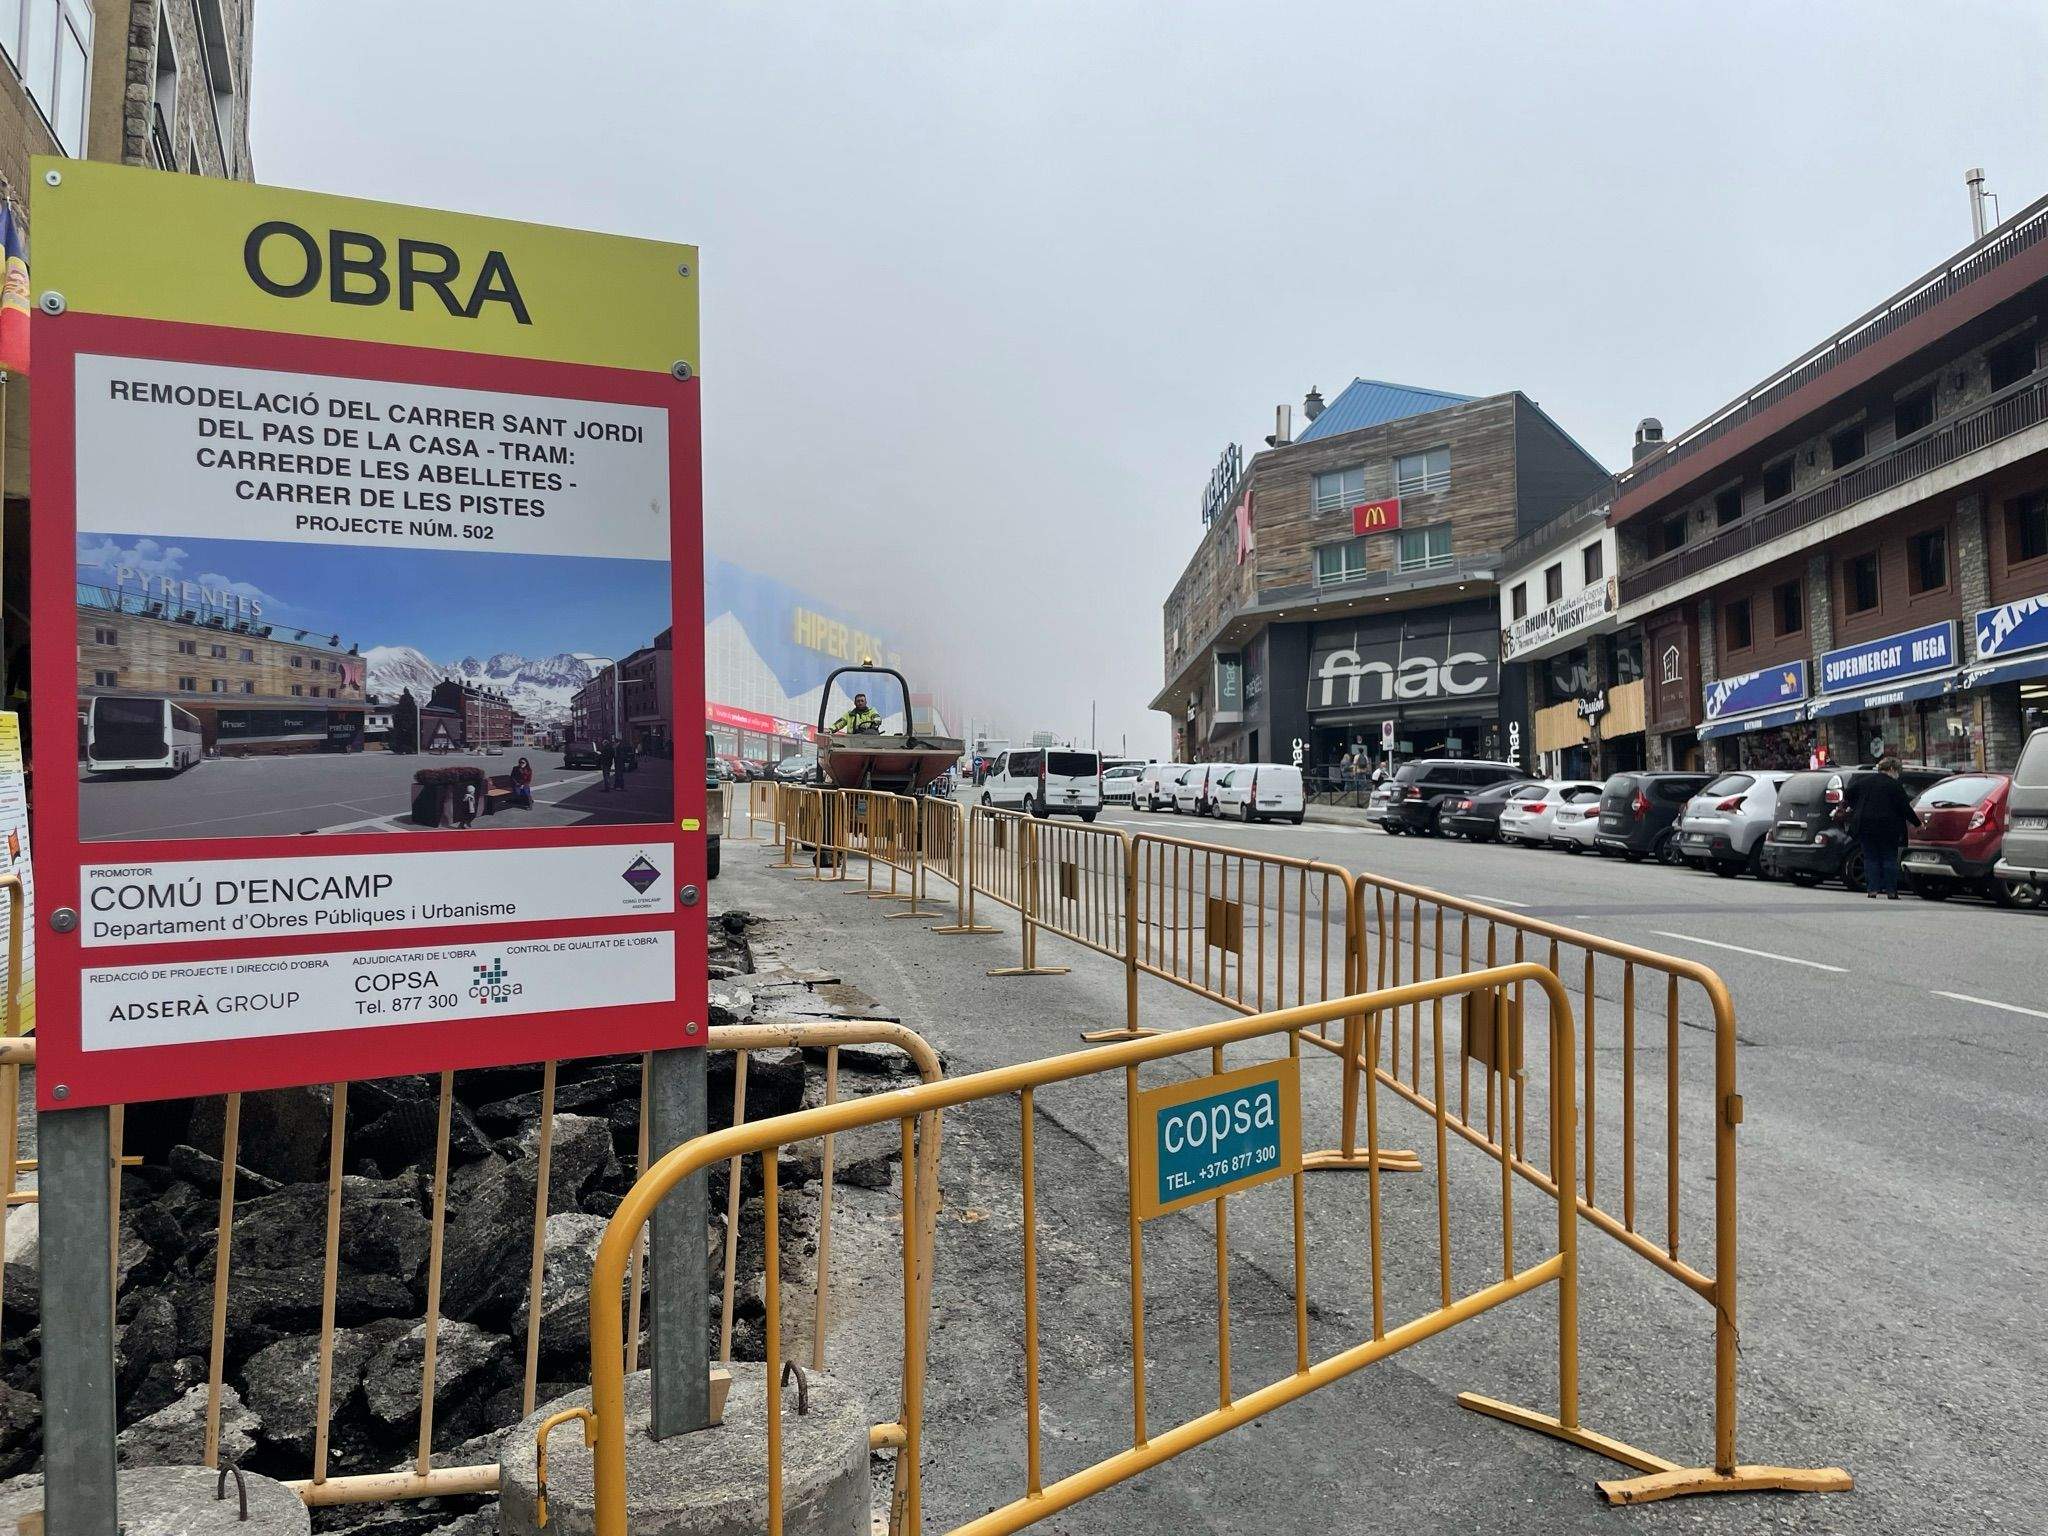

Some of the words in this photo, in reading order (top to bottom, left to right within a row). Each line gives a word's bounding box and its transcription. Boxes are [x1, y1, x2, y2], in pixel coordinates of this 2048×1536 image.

[244, 221, 533, 325] OBRA
[110, 380, 320, 416] REMODELACIÓ
[329, 399, 380, 422] DEL
[388, 404, 495, 431] CARRER
[502, 414, 568, 437] SANT
[574, 422, 643, 443] JORDI
[199, 418, 253, 441] DEL
[263, 422, 315, 445] PAS
[324, 427, 359, 449] DE
[368, 431, 401, 452] LA
[409, 434, 480, 458] CASA
[499, 442, 576, 465] TRAM:
[196, 448, 351, 477] CARRERDE
[361, 459, 410, 481] LES
[418, 464, 563, 491] ABELLETES
[235, 480, 351, 506] CARRER
[360, 488, 395, 509] DE
[403, 491, 452, 513] LES
[460, 495, 545, 518] PISTES
[296, 515, 403, 535] PROJECTE
[410, 519, 457, 538] NÚM.
[463, 525, 494, 539] 502
[794, 607, 848, 660] HIPER
[854, 630, 883, 668] PAS
[1525, 611, 1548, 634] RHUM
[1556, 605, 1585, 634] WHISKY
[1826, 646, 1902, 683] SUPERMERCAT
[1912, 635, 1946, 663] MEGA
[1223, 660, 1236, 697] fnac
[1318, 650, 1489, 706] fnac
[1865, 691, 1904, 708] SUPERMERCAT
[1292, 737, 1303, 772] nac
[1507, 721, 1520, 767] fnac
[90, 868, 153, 878] PROMOTOR
[91, 877, 201, 911] COMÚ
[216, 874, 393, 905] D'ENCAMP
[94, 915, 226, 939] Departament
[315, 908, 406, 926] Públiques
[411, 905, 416, 919] i
[422, 902, 516, 919] Urbanisme
[352, 953, 425, 965] ADJUDICATARI
[427, 952, 440, 961] DE
[442, 950, 477, 959] L'OBRA
[506, 945, 551, 955] CONTROL
[553, 943, 566, 951] DE
[568, 940, 611, 950] QUALITAT
[613, 939, 625, 947] DE
[627, 937, 659, 946] L'OBRA
[90, 971, 149, 984] REDACCIÓ
[152, 970, 167, 980] DE
[170, 967, 227, 978] PROJECTE
[237, 962, 288, 974] DIRECCIÓ
[290, 960, 330, 969] D'OBRA
[355, 971, 439, 993] COPSA
[109, 994, 210, 1022] ADSERÀ
[216, 991, 300, 1014] GROUP
[355, 1000, 386, 1015] Tel.
[392, 996, 422, 1012] 877
[428, 994, 458, 1009] 300
[468, 983, 523, 1000] copsa
[1165, 1093, 1274, 1153] copsa
[1167, 1170, 1196, 1190] TEL.
[1199, 1160, 1229, 1179] +376
[1232, 1152, 1252, 1171] 877
[1256, 1145, 1276, 1164] 300
